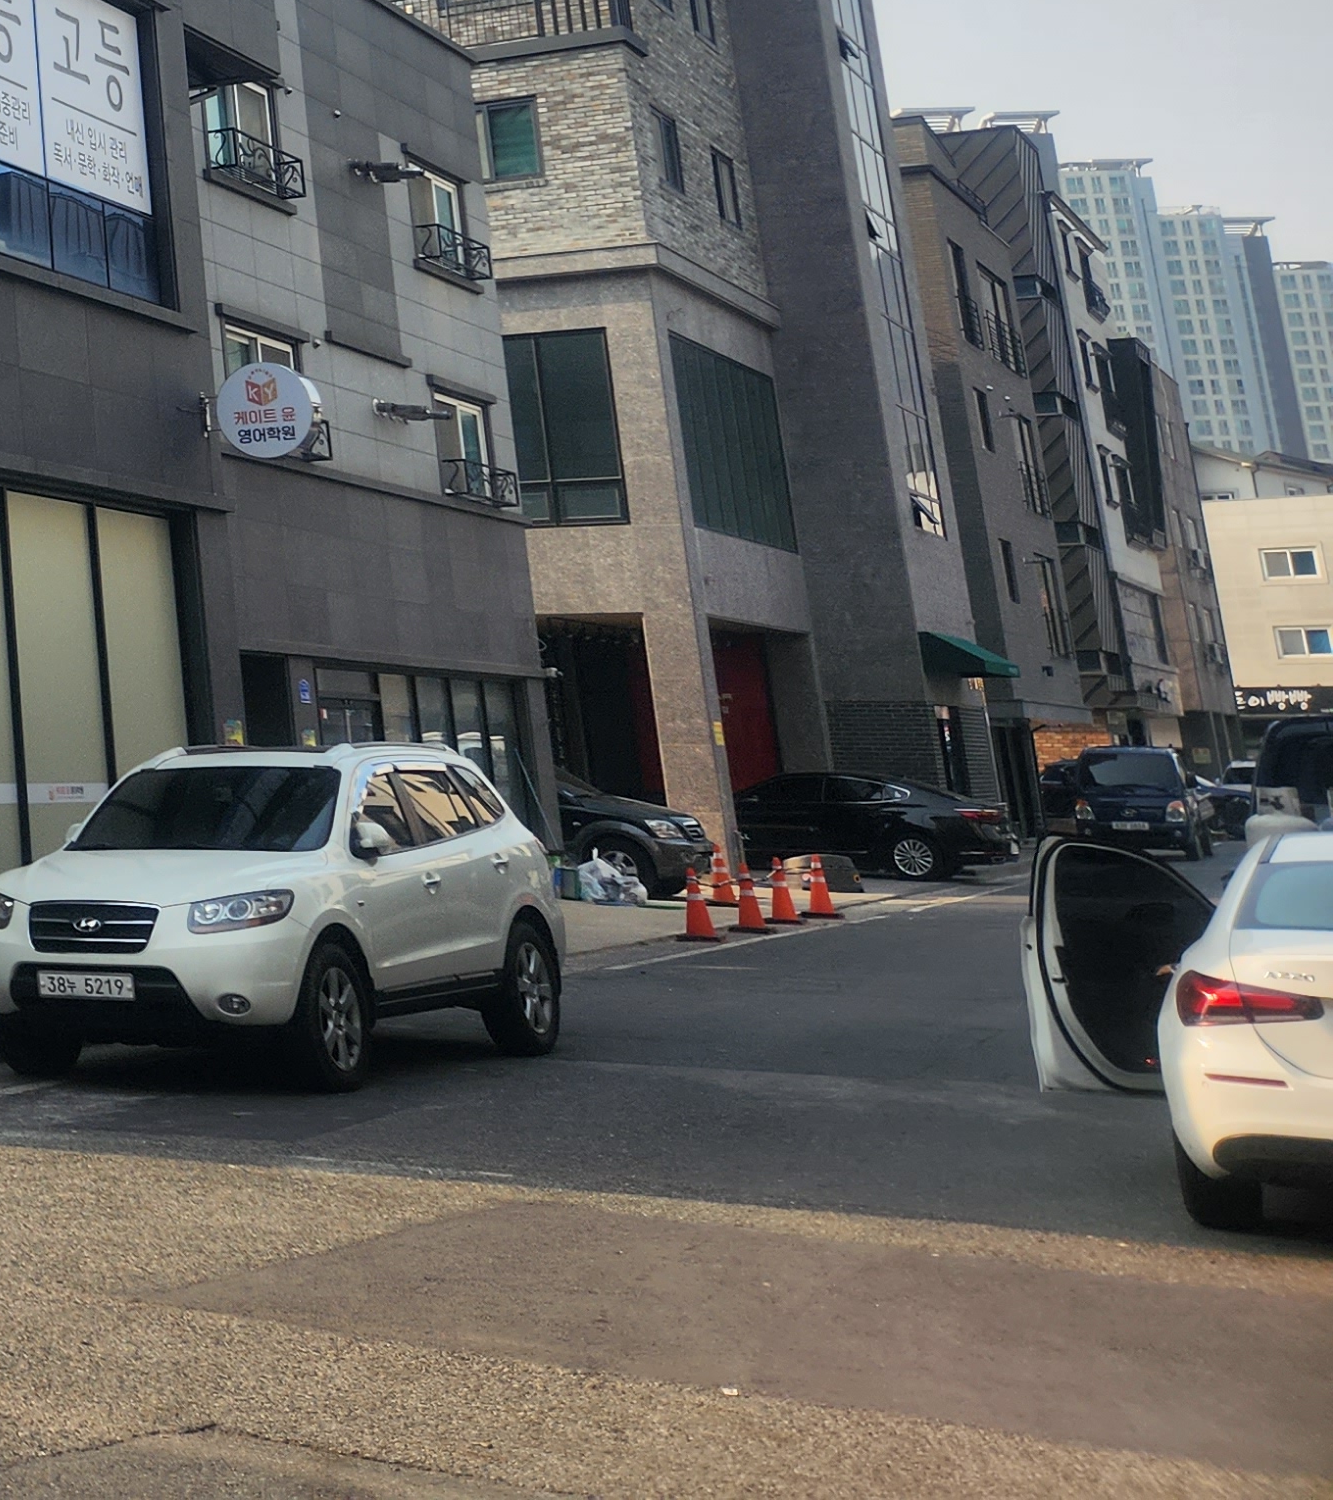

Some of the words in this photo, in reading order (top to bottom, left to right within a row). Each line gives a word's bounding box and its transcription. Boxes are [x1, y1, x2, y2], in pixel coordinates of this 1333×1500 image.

[52, 5, 131, 113] 고등
[65, 118, 85, 146] 내신
[87, 126, 107, 155] 입시
[109, 136, 128, 164] 관리
[234, 409, 278, 426] 케이트
[281, 406, 297, 423] 윤
[238, 425, 297, 445] 영어학원
[46, 975, 77, 993] 38누
[84, 977, 124, 996] 5219
